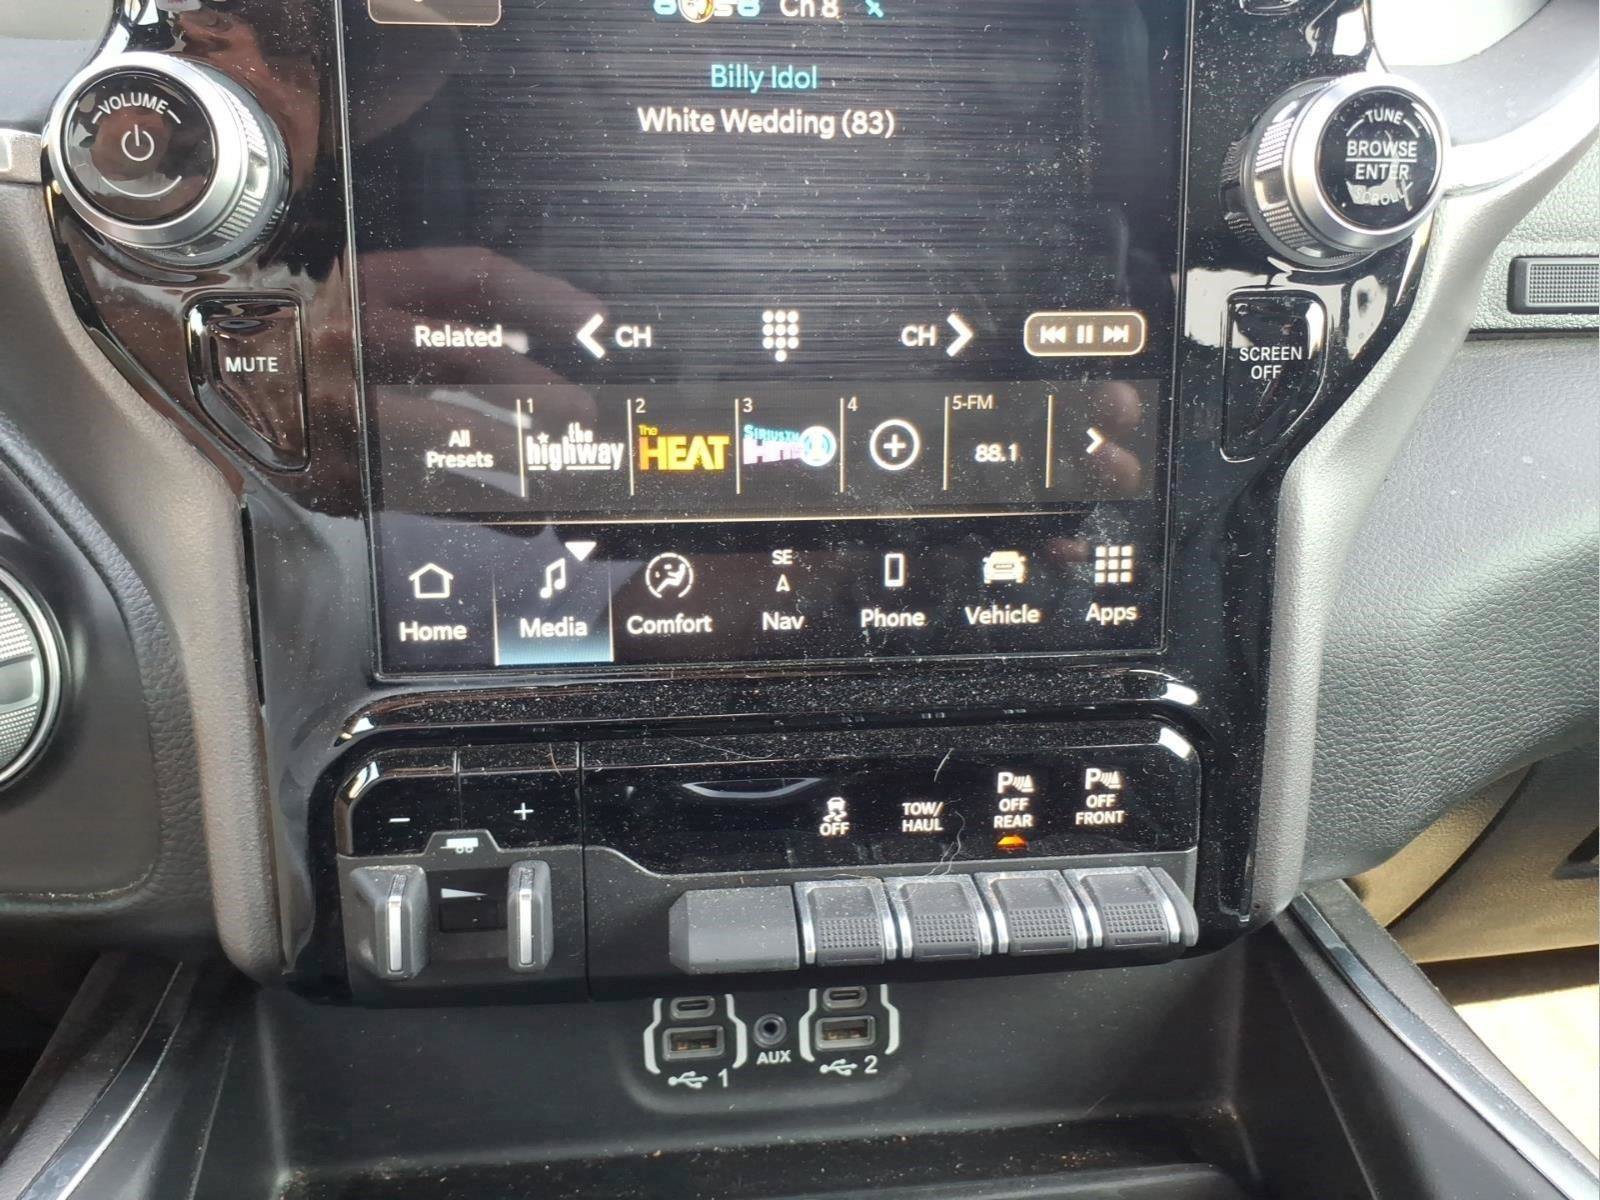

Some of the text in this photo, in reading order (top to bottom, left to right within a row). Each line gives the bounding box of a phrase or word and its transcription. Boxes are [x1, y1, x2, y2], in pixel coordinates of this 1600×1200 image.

[710, 64, 818, 93] Billy Idol
[98, 92, 169, 115] VOLUME
[637, 107, 895, 140] White Wedding (83)
[1365, 107, 1404, 125] TUNE
[1346, 140, 1418, 158] BROWSE
[1355, 163, 1410, 181] ENTER
[414, 323, 503, 349] Related
[614, 325, 653, 349] CH
[901, 325, 938, 348] CH
[1239, 346, 1303, 363] SCREEN
[224, 356, 279, 374] MUTE
[1250, 364, 1283, 381] OFF
[526, 398, 534, 413] 1
[635, 398, 647, 414] 2
[742, 398, 754, 414] 3
[846, 397, 858, 413] 4
[952, 394, 994, 410] 5-FM
[448, 429, 472, 449] All
[567, 421, 594, 444] the
[638, 424, 659, 436] The
[425, 450, 495, 469] Presets
[526, 435, 624, 471] highway
[638, 435, 729, 471] HEAT
[974, 443, 1019, 463] 88.1
[772, 549, 793, 565] SE
[761, 611, 805, 631] Nav
[860, 608, 926, 629] Phone
[964, 604, 1040, 626] Vehicle
[1085, 602, 1138, 626] Apps
[399, 620, 468, 643] Home
[519, 617, 589, 639] Media
[626, 614, 713, 636] Comfort
[902, 801, 943, 816] TOW/
[998, 798, 1029, 812] OFF
[1085, 794, 1116, 809] OFF
[901, 818, 944, 833] HAUL
[993, 814, 1034, 829] REAR
[1075, 810, 1125, 826] FRONT
[819, 821, 850, 837] OFF
[756, 1049, 792, 1065] AUX
[863, 1055, 879, 1074] 2
[717, 1068, 729, 1088] 1
